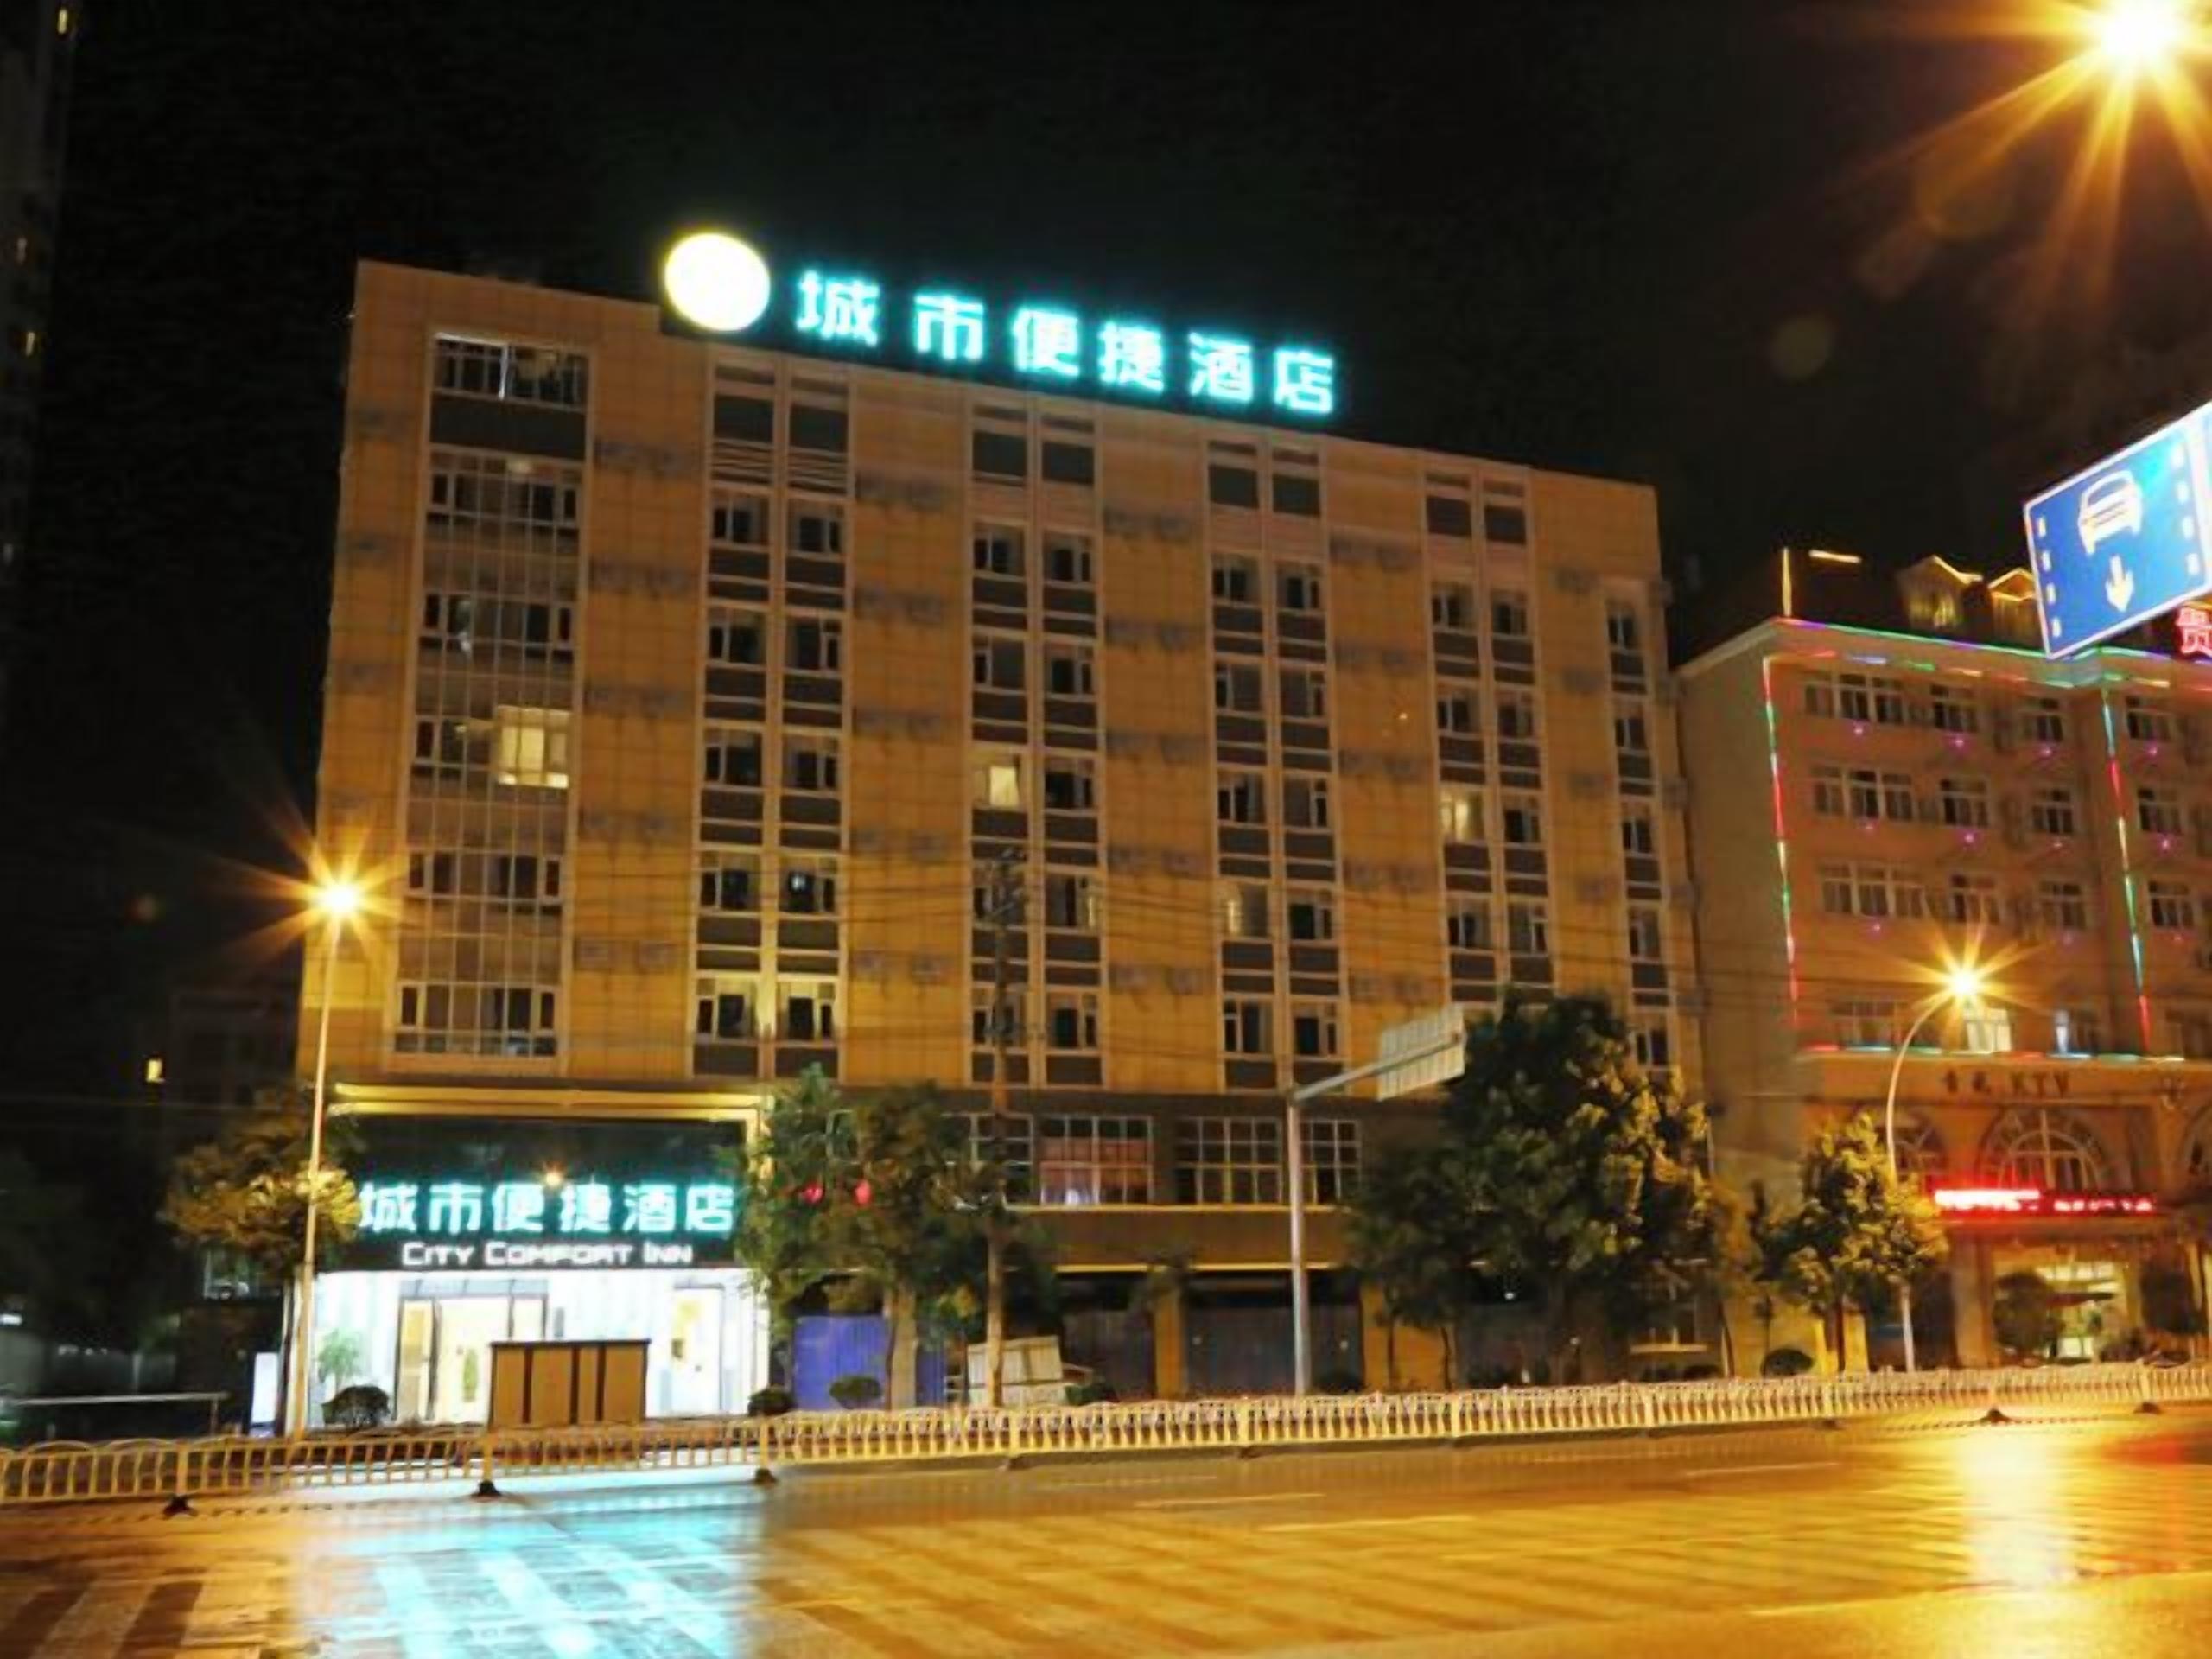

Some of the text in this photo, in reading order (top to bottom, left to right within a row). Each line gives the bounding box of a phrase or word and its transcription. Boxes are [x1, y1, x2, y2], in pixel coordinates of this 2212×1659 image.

[793, 267, 1336, 415] 城市便捷酒店
[358, 1181, 737, 1235] 城市便捷酒店
[483, 1241, 633, 1266] COMFORT
[641, 1241, 694, 1266] INN
